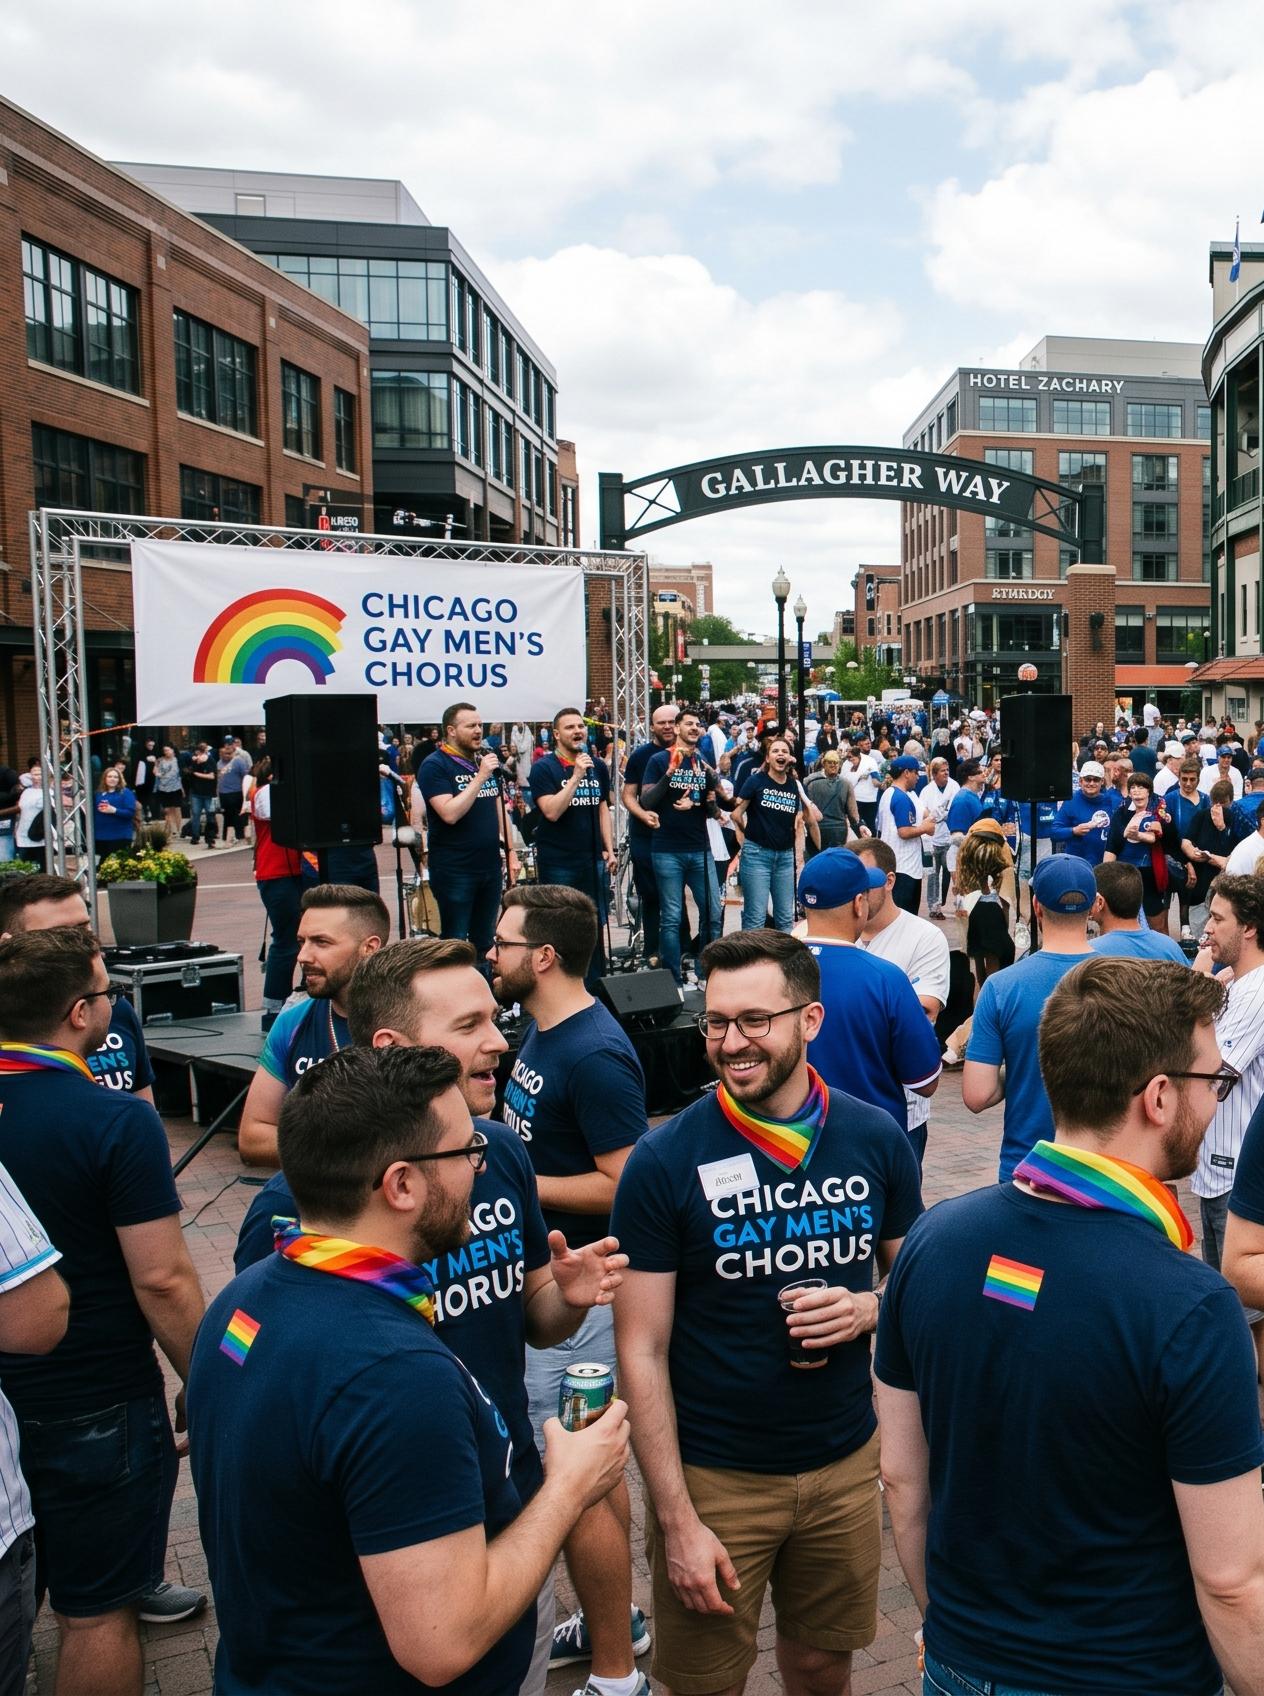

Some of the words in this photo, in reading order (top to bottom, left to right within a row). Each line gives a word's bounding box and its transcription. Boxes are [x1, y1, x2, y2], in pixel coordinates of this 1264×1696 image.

[969, 372, 1031, 391] HOTEL
[1037, 374, 1125, 395] ZACHARY
[700, 458, 925, 501] GALLAGHER
[934, 466, 1011, 506] WAY
[361, 592, 518, 624] CHICAGO
[363, 626, 432, 654] GAY
[444, 629, 544, 657] MEN'S
[364, 660, 508, 688] CHORUS
[710, 1175, 870, 1219] CHICAGO
[713, 1216, 777, 1248] GAY
[785, 1204, 873, 1239] MEN'S
[447, 1228, 523, 1279] MEN'S
[715, 1233, 873, 1280] CHORUS
